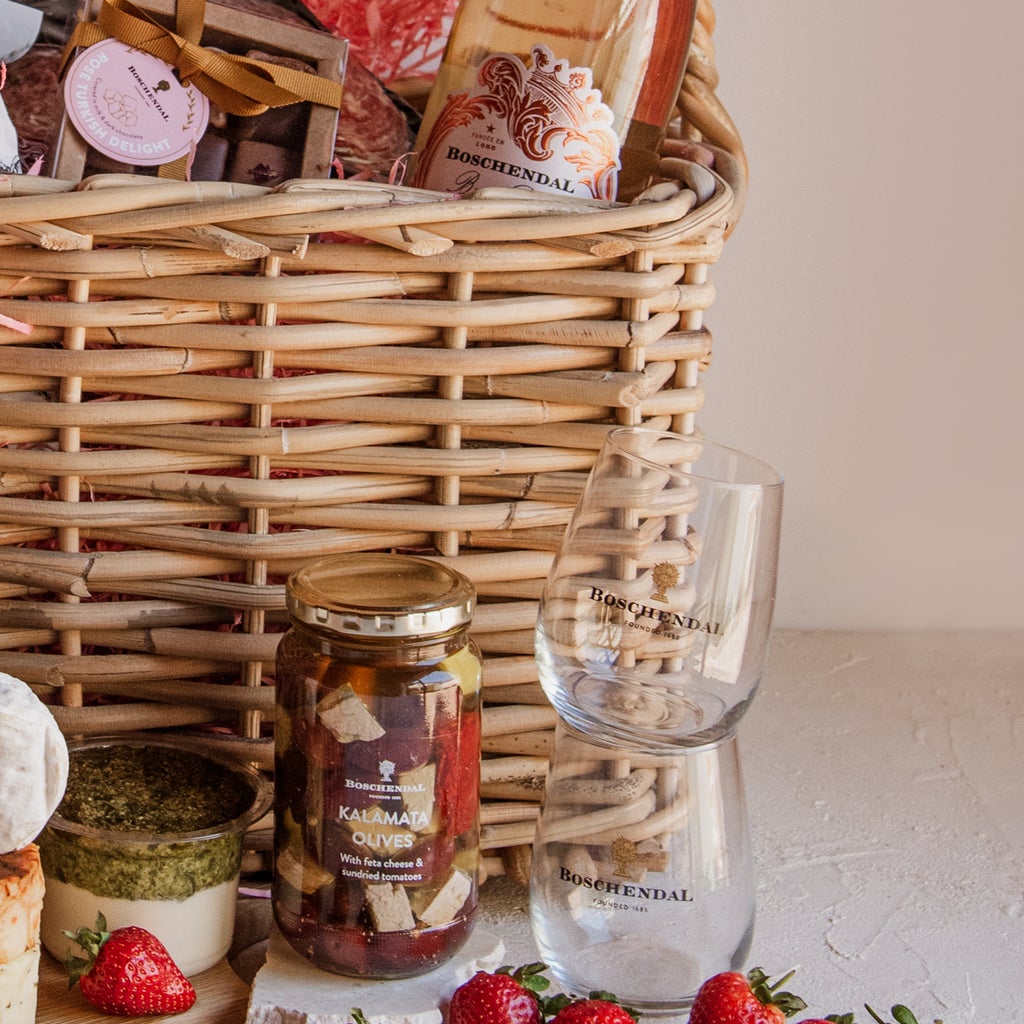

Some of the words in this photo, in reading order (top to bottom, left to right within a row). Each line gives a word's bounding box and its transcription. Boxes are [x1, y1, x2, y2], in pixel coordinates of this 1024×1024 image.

[79, 52, 109, 82] ROSE
[127, 65, 170, 122] BOSCHENDAL
[75, 83, 108, 139] TURKISH
[108, 138, 172, 154] DELIGHT
[447, 146, 575, 193] BOSCHENDAL
[588, 586, 725, 636] BOSCHENDAL
[624, 620, 661, 635] FOUNDED
[345, 779, 426, 792] BOSCHENDAL
[338, 805, 429, 826] KALAMATA
[352, 831, 413, 848] OLIVES
[340, 853, 362, 865] With
[363, 857, 382, 867] feta
[383, 858, 414, 868] cheese
[415, 857, 424, 867] &
[341, 867, 380, 881] sundried
[381, 872, 423, 881] tomatoes
[559, 866, 693, 902] BOSCHENDAL
[592, 898, 629, 910] FOUNDED
